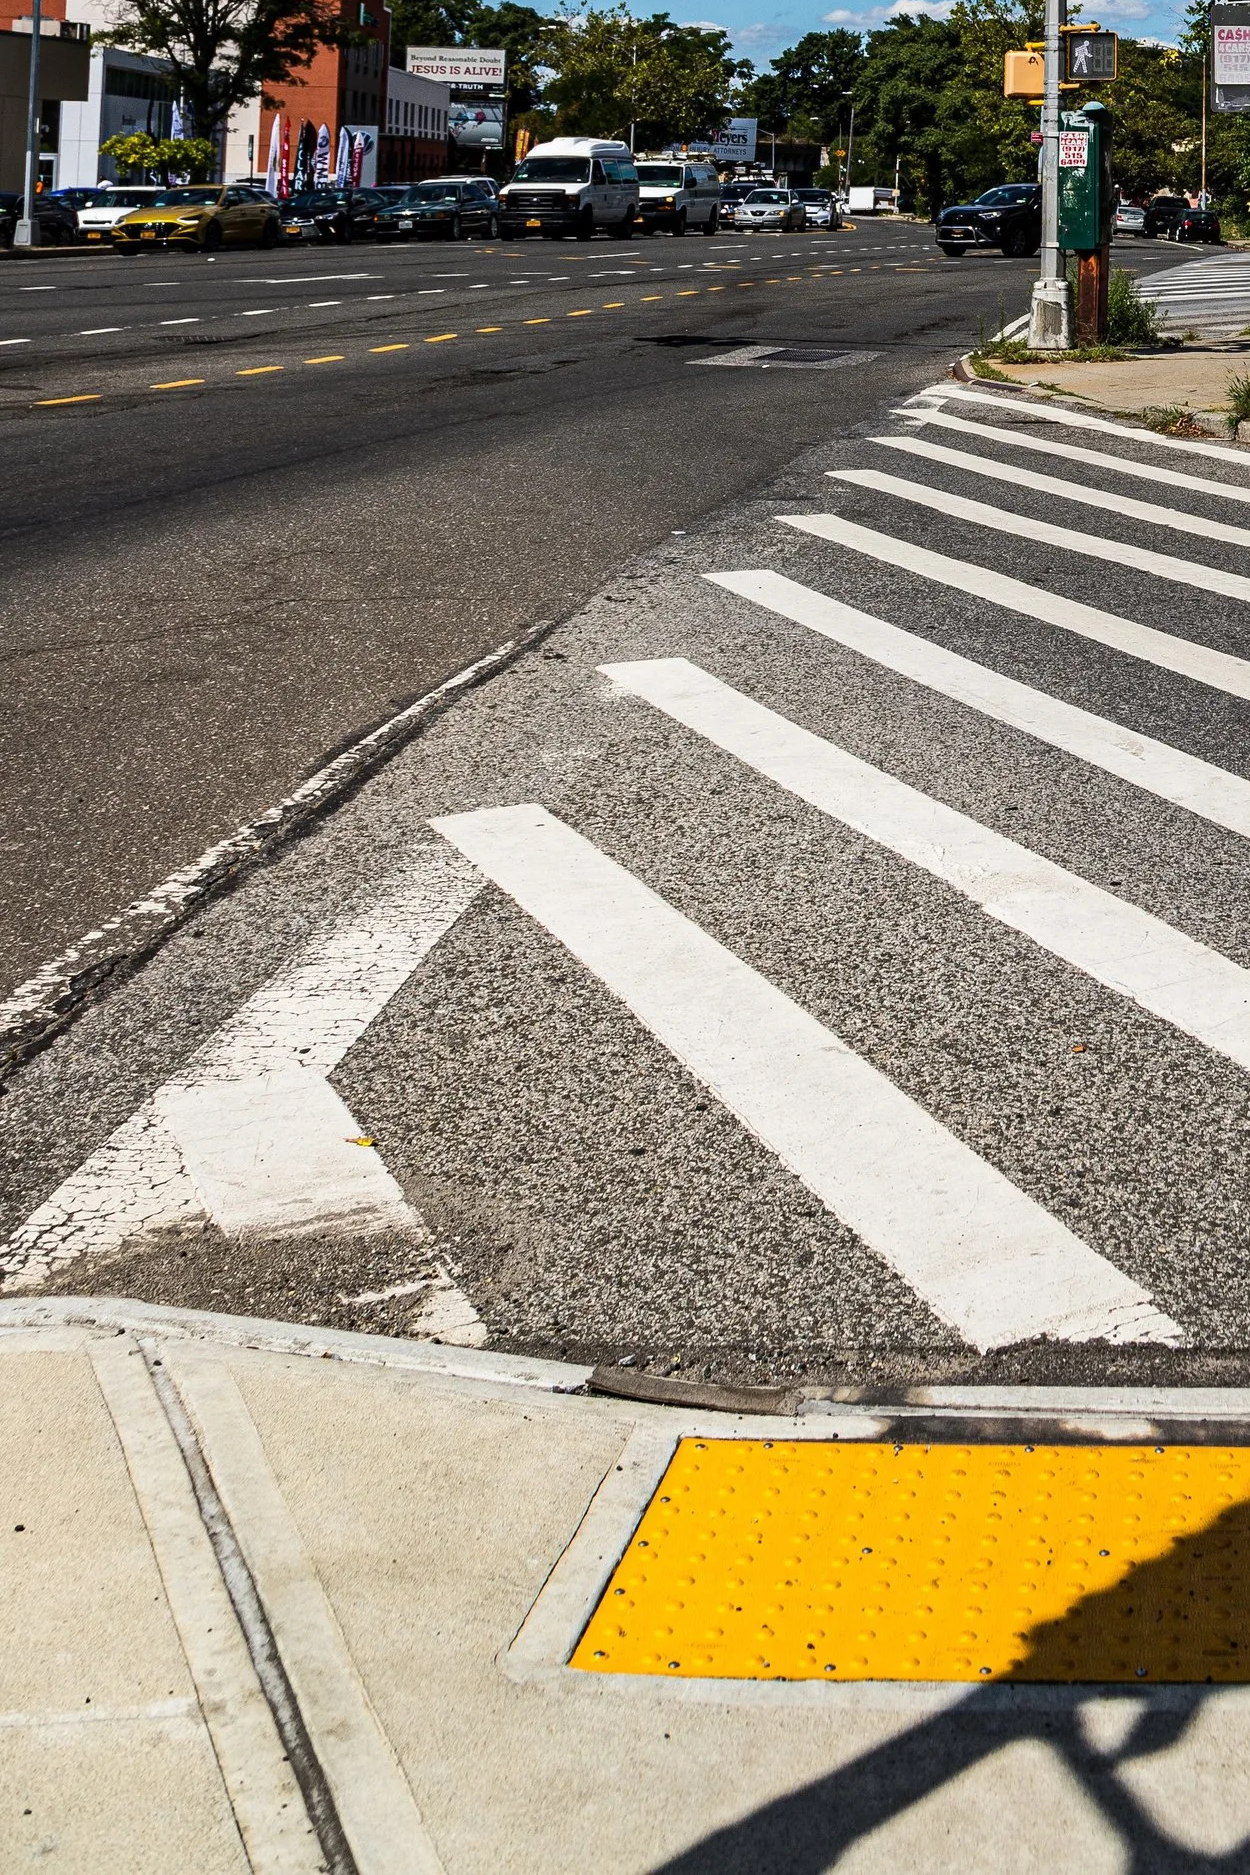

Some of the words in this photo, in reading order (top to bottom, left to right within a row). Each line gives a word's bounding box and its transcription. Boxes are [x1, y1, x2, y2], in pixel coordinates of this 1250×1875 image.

[411, 54, 436, 62] Beyond
[438, 55, 477, 63] Reasonable
[1219, 55, 1250, 63] (917)
[409, 65, 447, 74] JESUS
[449, 66, 460, 74] IS
[464, 66, 502, 76] ALIVE!
[1223, 64, 1248, 72] 515
[447, 82, 484, 90] R-TRUTH
[714, 147, 747, 156] ATTORNEYS
